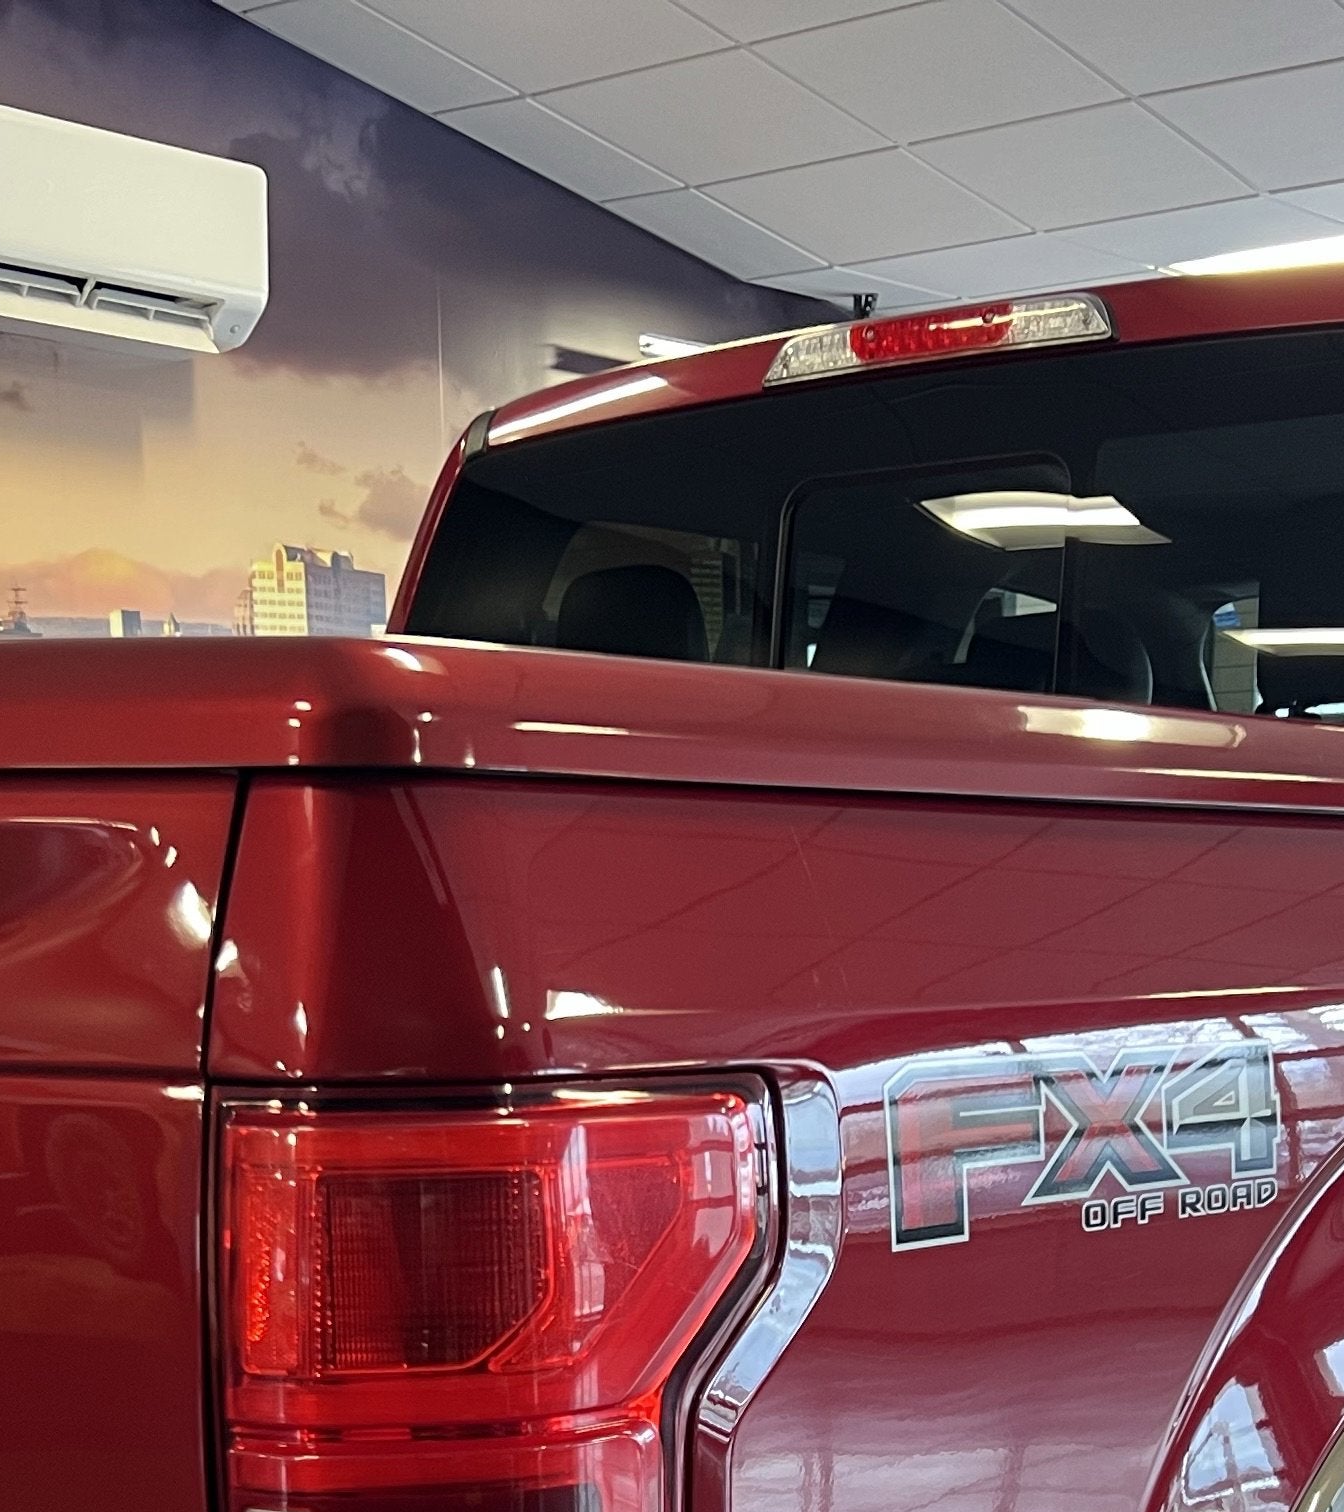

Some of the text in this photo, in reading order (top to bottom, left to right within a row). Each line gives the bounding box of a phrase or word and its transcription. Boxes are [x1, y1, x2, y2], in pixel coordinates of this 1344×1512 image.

[882, 1038, 1282, 1253] FX4
[1082, 1177, 1279, 1232] OFF ROAD
